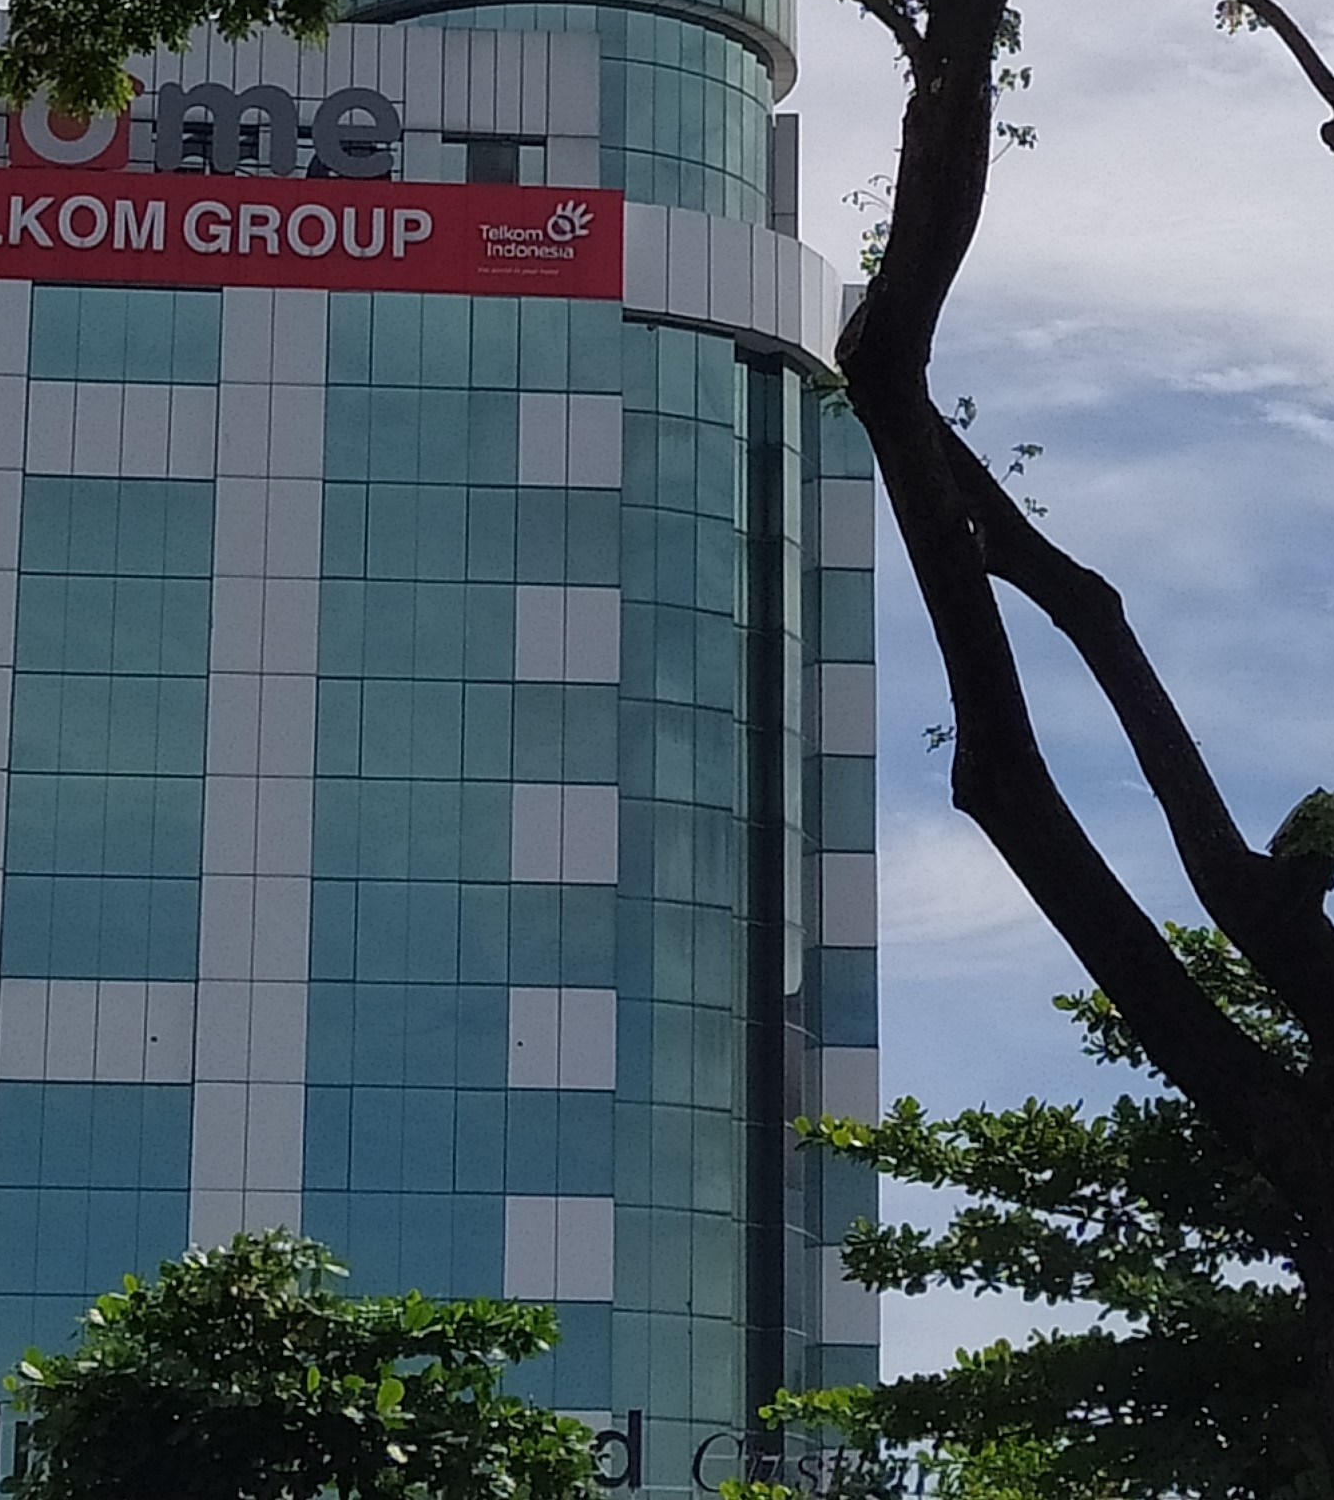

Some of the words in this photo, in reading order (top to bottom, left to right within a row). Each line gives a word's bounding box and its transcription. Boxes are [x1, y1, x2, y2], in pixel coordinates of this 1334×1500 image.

[183, 200, 433, 258] GROUP
[479, 224, 544, 242] Telkom
[486, 242, 575, 260] Indonesia
